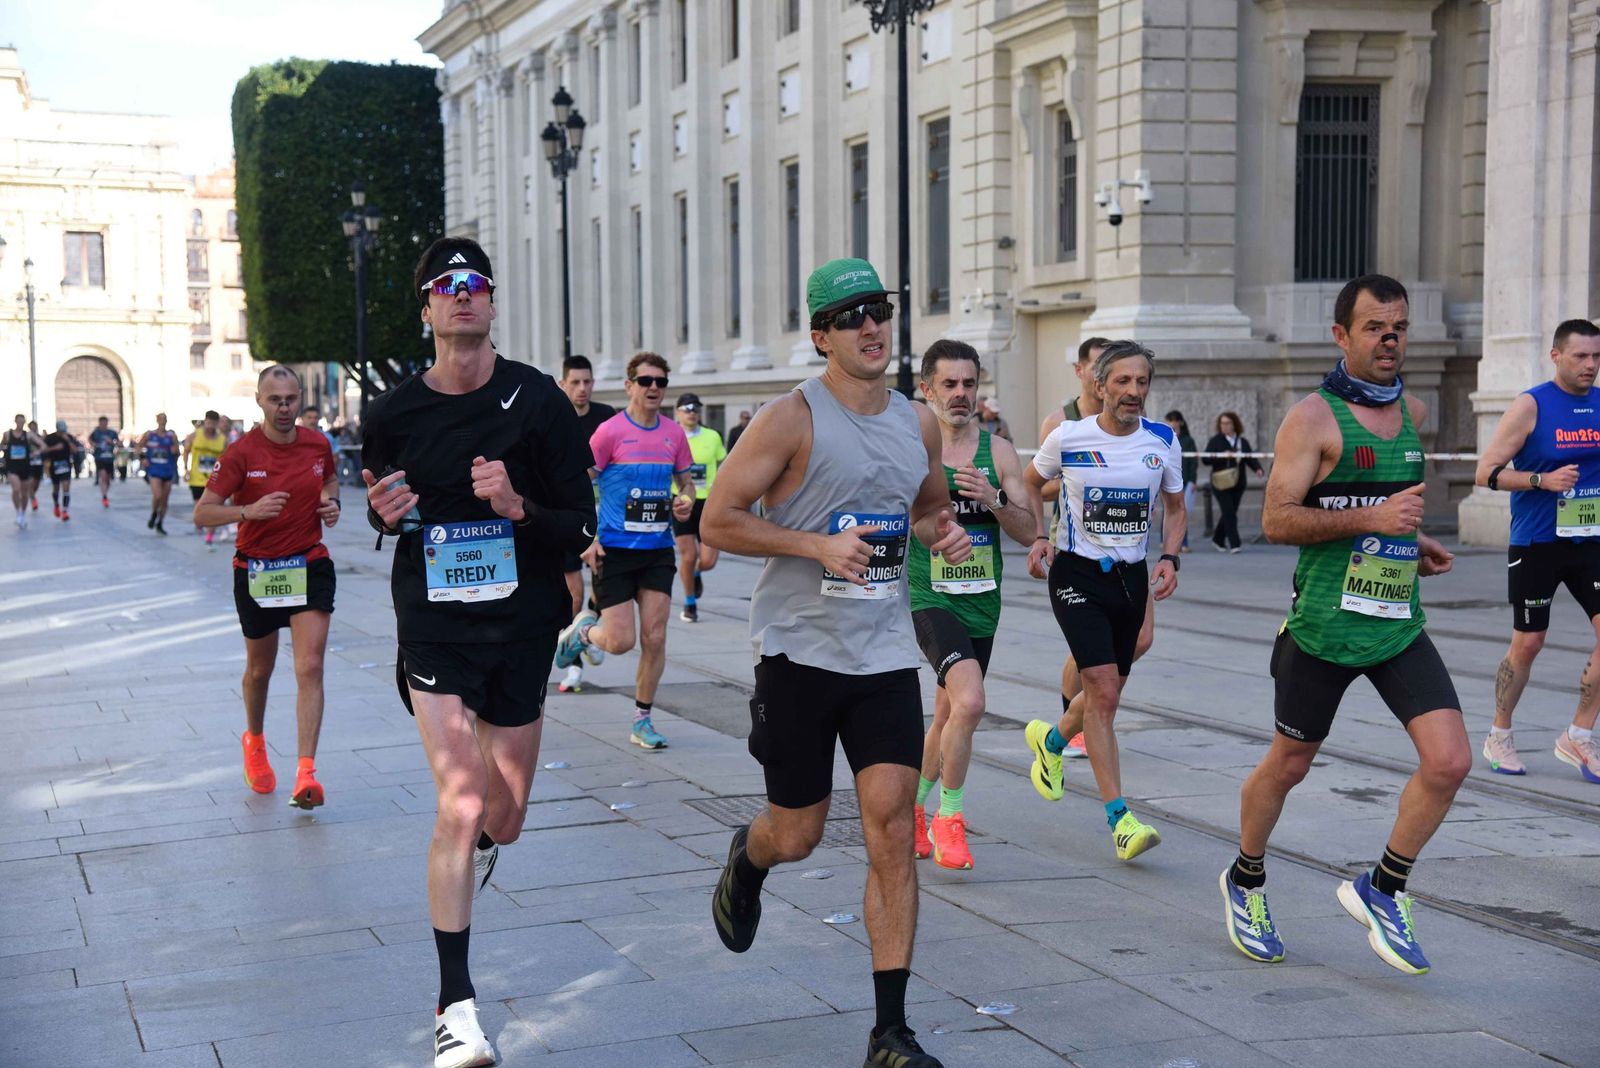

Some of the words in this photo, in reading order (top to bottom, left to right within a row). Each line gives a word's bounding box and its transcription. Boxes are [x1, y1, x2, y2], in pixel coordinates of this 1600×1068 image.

[246, 470, 267, 478] HOKA
[643, 489, 668, 497] ZURICH
[1106, 490, 1144, 500] ZURICH
[643, 502, 657, 510] 5317
[641, 511, 657, 522] FLY
[1106, 507, 1127, 518] 4659
[1578, 513, 1596, 524] TIM
[452, 525, 502, 539] ZURICH
[1084, 520, 1148, 533] PIERANGELO
[968, 534, 988, 543] RICH
[455, 549, 482, 563] 5560
[1385, 544, 1418, 557] ZURICH
[268, 559, 300, 569] ZURICH
[445, 564, 497, 584] FREDY
[863, 564, 902, 581] QUIGLEY
[941, 566, 986, 579] IBORRA
[1380, 567, 1402, 579] 3361
[265, 584, 292, 595] FRED
[1346, 576, 1412, 600] MATINAES
